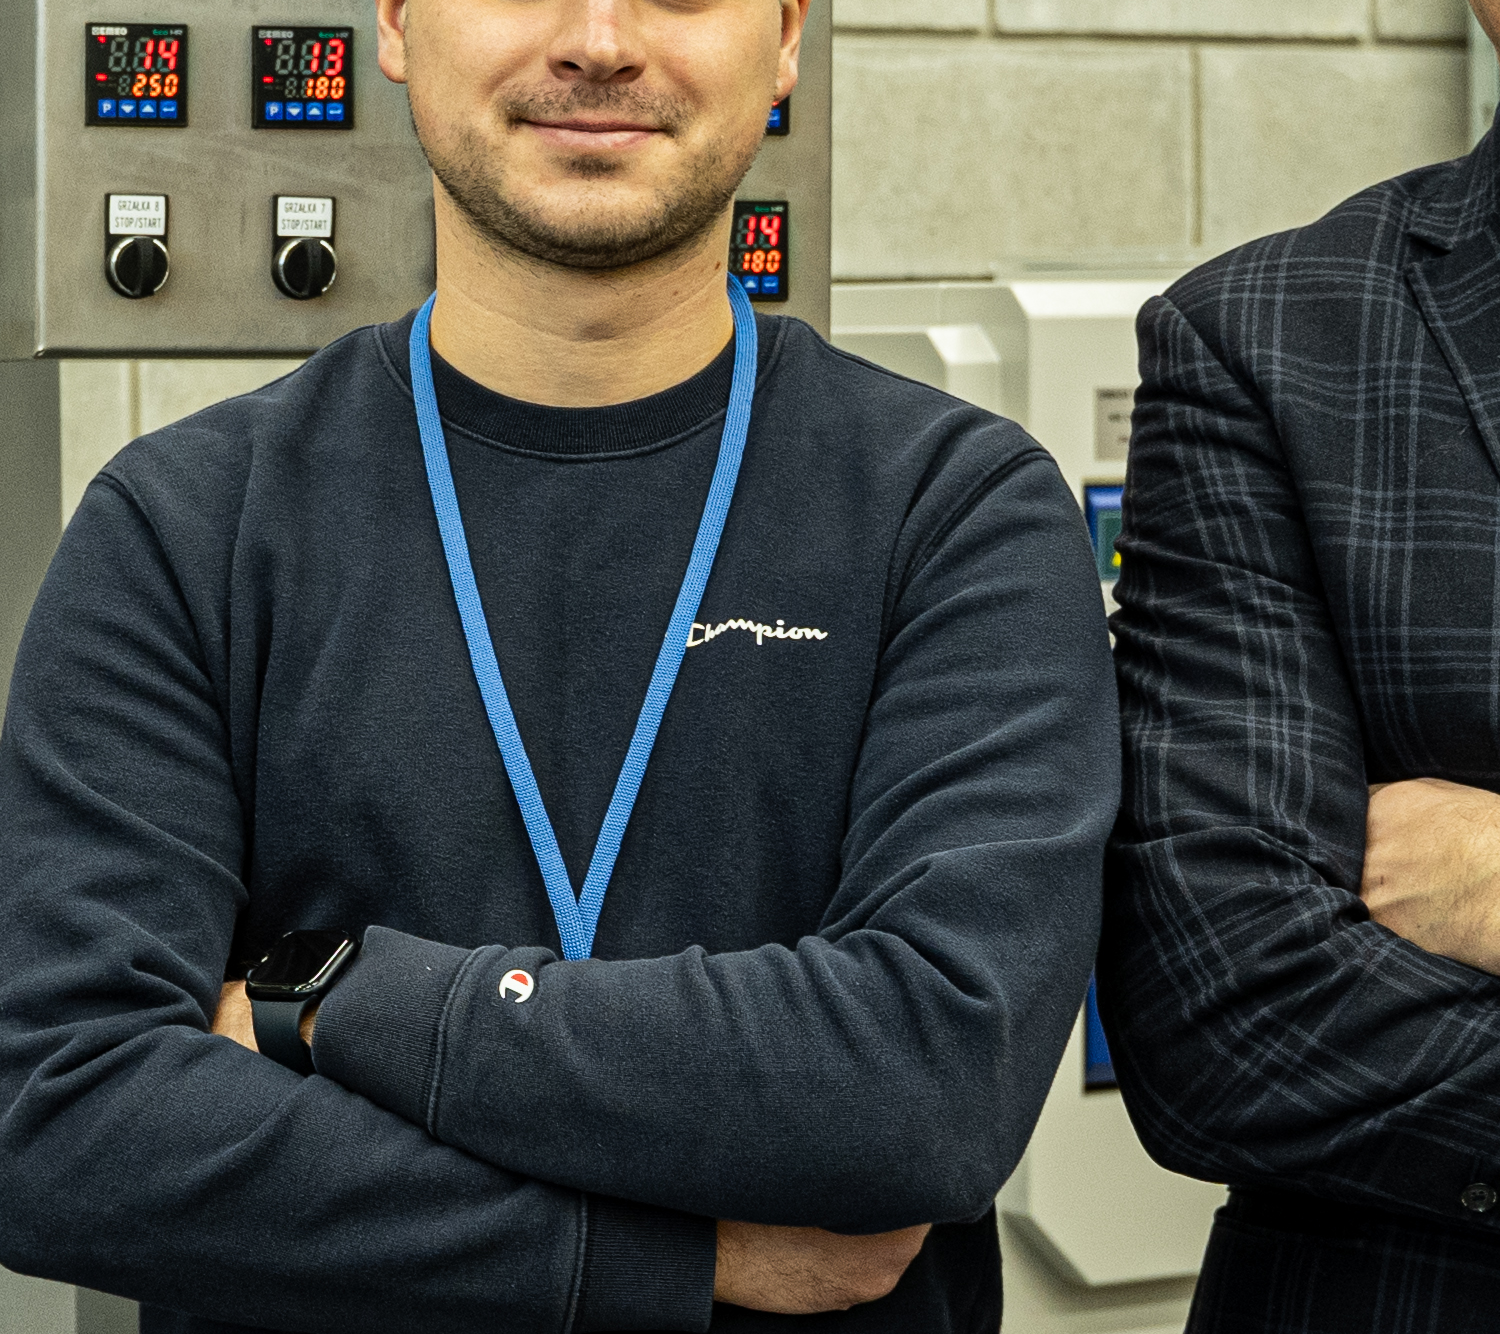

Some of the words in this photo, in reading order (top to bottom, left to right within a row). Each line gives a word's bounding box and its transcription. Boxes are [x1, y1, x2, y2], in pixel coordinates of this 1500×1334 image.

[143, 39, 180, 71] 14
[310, 38, 346, 76] 13
[132, 73, 180, 98] 250
[305, 76, 346, 99] 180
[102, 103, 112, 114] P
[269, 106, 279, 116] P
[117, 200, 151, 212] GRZAŁKA
[284, 202, 317, 213] GRZAŁKA
[321, 203, 326, 213] 7
[114, 216, 162, 229] STOP/START
[281, 218, 328, 231] STOP/START
[745, 214, 782, 247] 14
[742, 249, 782, 274] 180
[684, 618, 829, 647] Champion
